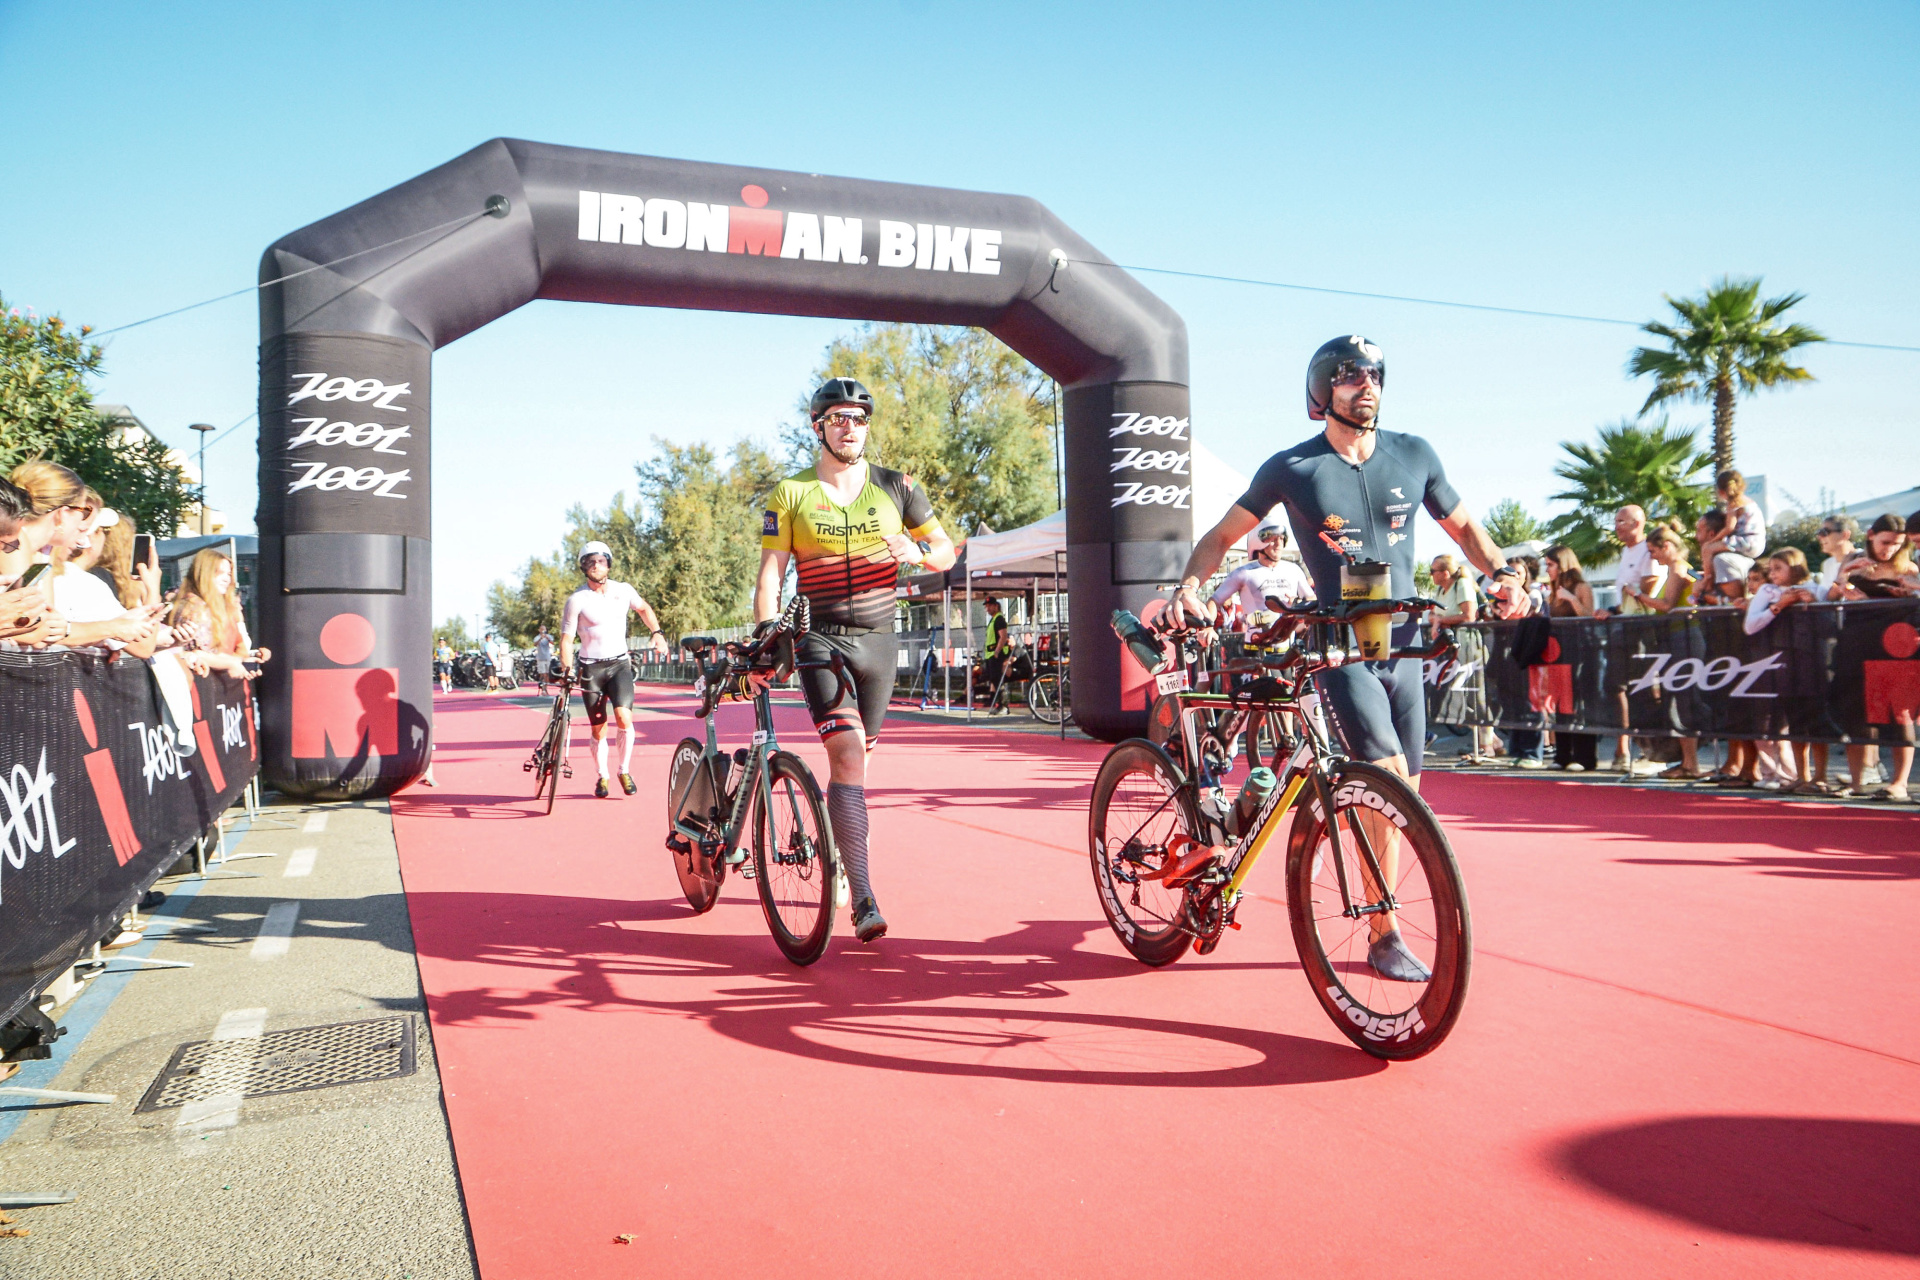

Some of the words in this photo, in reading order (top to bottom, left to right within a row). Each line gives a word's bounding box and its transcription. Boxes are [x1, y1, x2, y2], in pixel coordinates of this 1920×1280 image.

[578, 186, 864, 265] IRONMAN
[878, 219, 1002, 275] BIKE
[815, 520, 881, 537] TRISTYLE
[816, 537, 859, 545] TRIATHLON
[862, 535, 882, 543] TEAM
